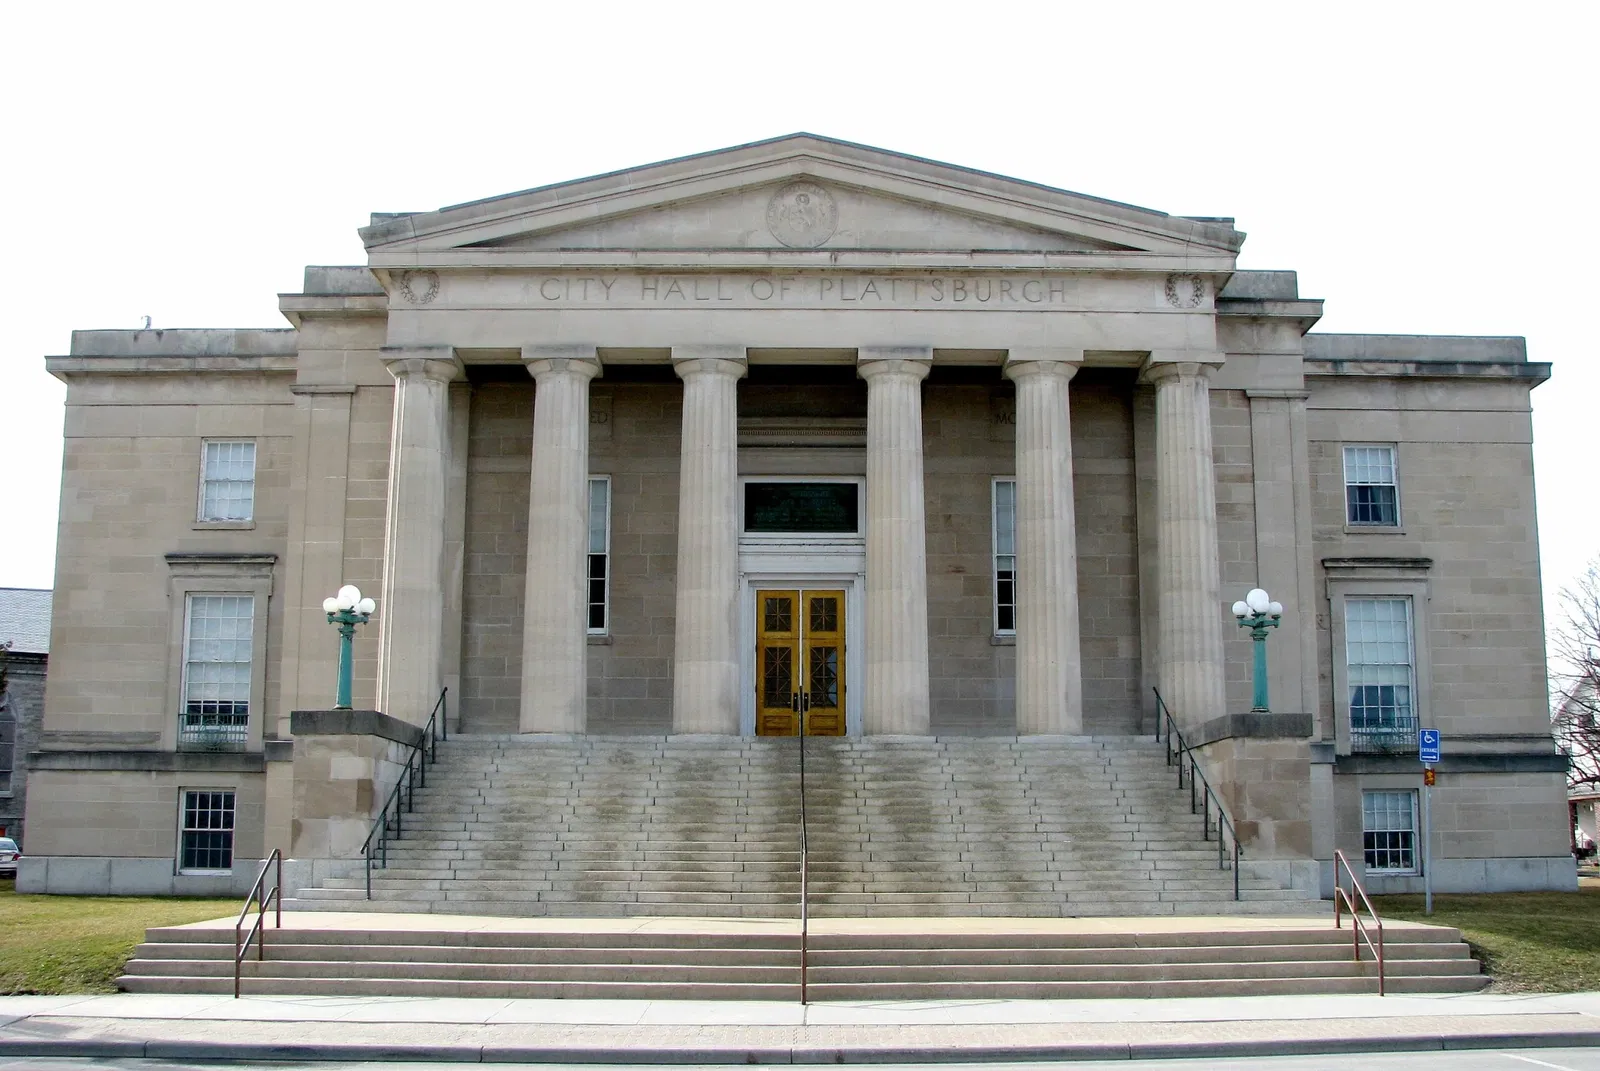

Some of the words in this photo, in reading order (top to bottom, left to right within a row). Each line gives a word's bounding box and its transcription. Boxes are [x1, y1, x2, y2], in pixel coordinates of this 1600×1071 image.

[540, 278, 617, 301] CITY
[641, 278, 733, 301] HALL
[751, 278, 795, 301] OF
[819, 278, 1066, 303] PLATTSBURGH
